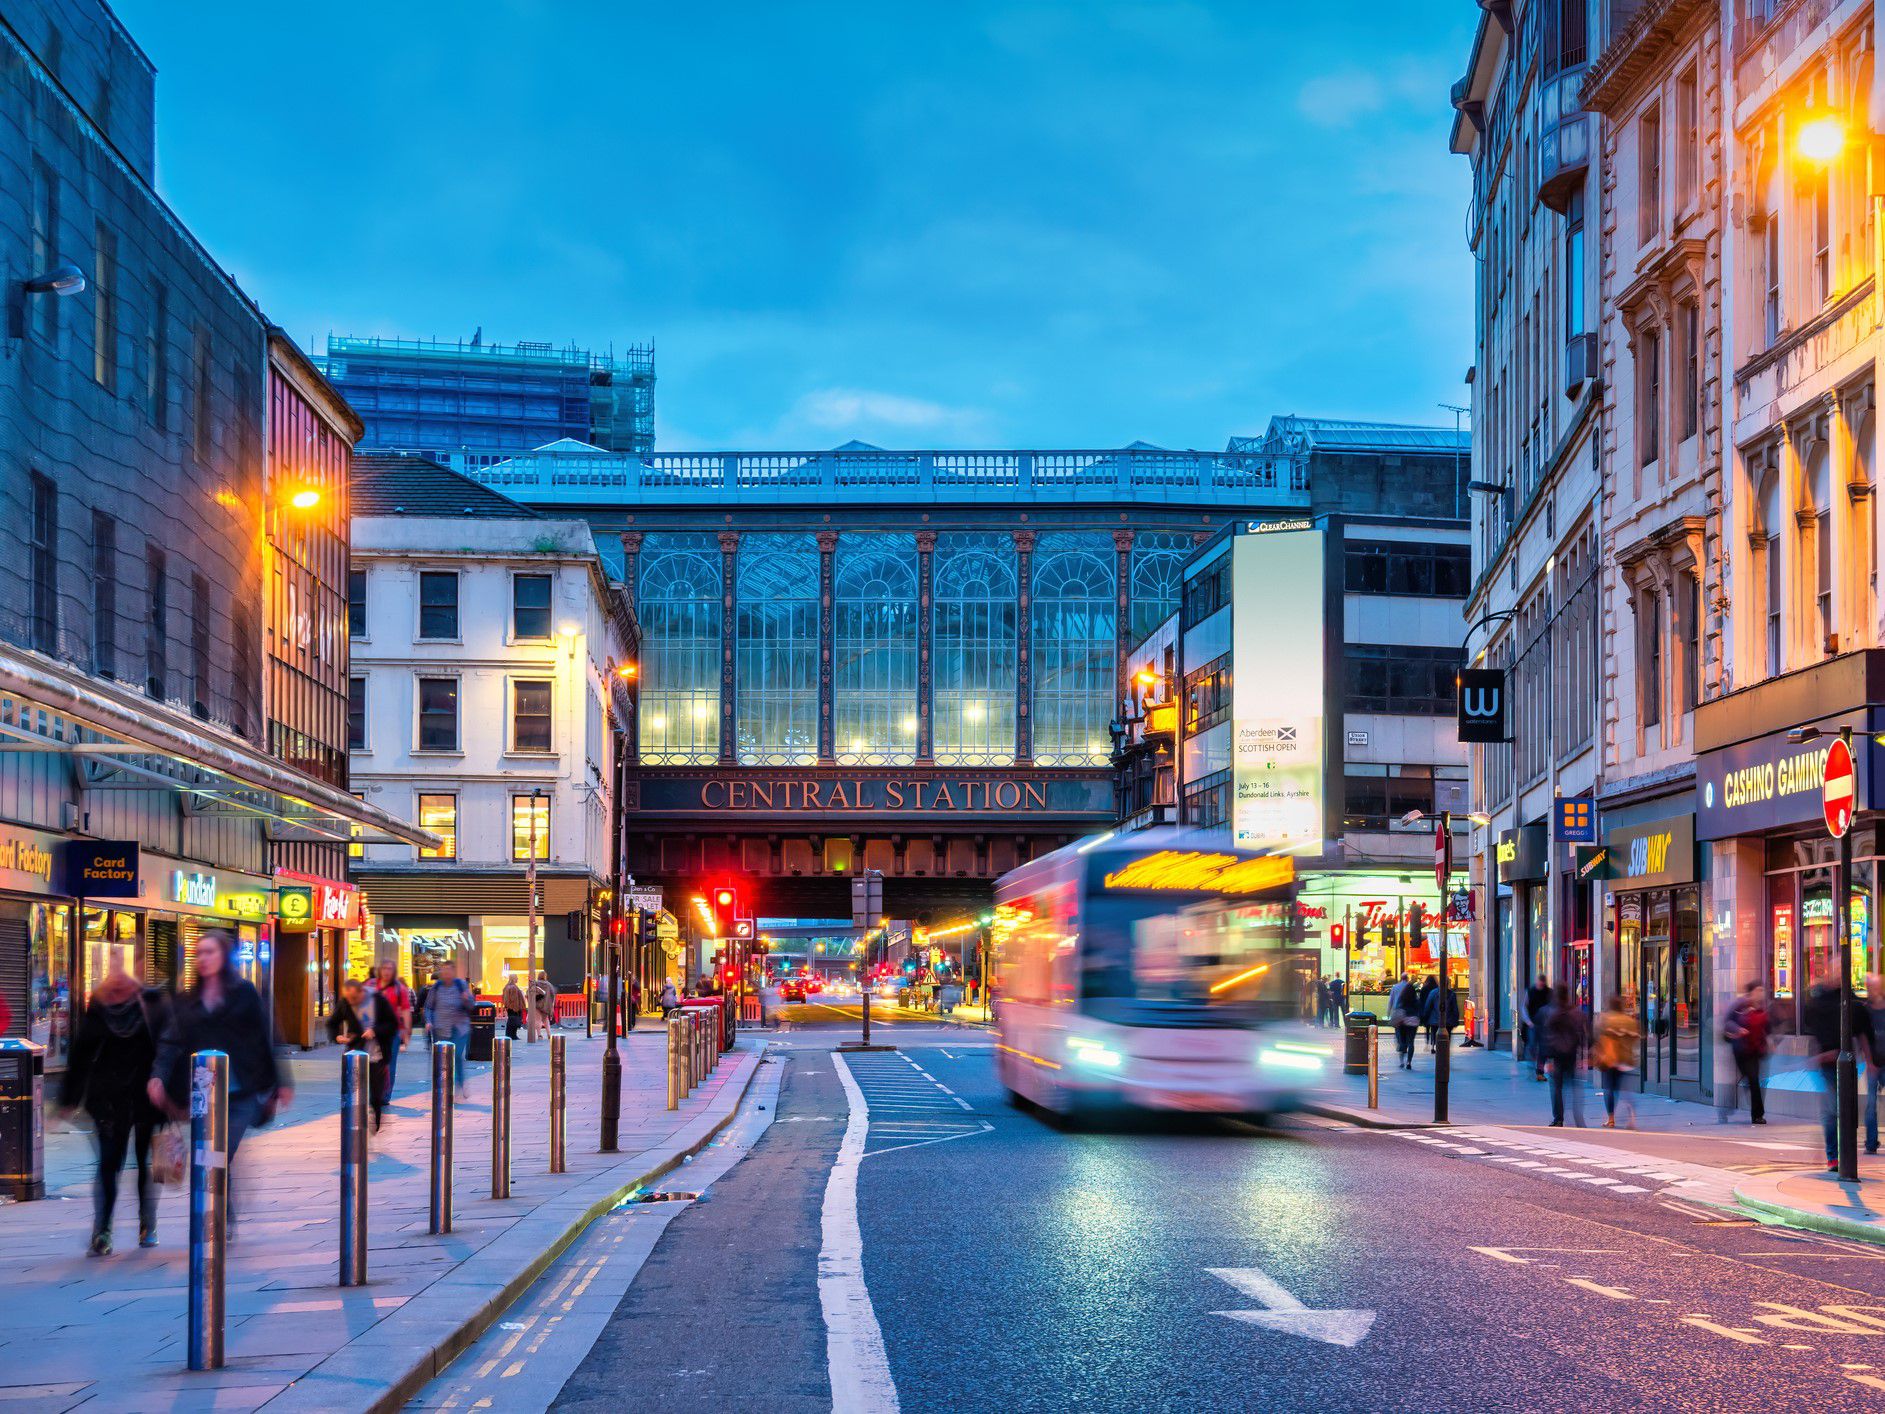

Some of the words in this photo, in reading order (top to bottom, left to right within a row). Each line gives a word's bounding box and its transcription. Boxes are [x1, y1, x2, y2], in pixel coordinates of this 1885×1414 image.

[1239, 728, 1276, 738] Aberdeen
[1238, 744, 1274, 753] SCOTTISH
[1276, 743, 1297, 752] OPEN
[701, 780, 875, 809] CENTRAL
[886, 780, 1048, 809] STATION
[1238, 782, 1249, 791] July
[1238, 791, 1269, 799] Dundonald
[1286, 790, 1310, 798] Ayrshire
[1724, 762, 1774, 809] CASHINO
[18, 841, 52, 882] Factory
[94, 857, 125, 868] Card
[1580, 849, 1607, 878] SUBWAY
[1628, 831, 1672, 877] SUBWAY
[83, 868, 134, 882] Factory
[176, 870, 216, 907] Poundland
